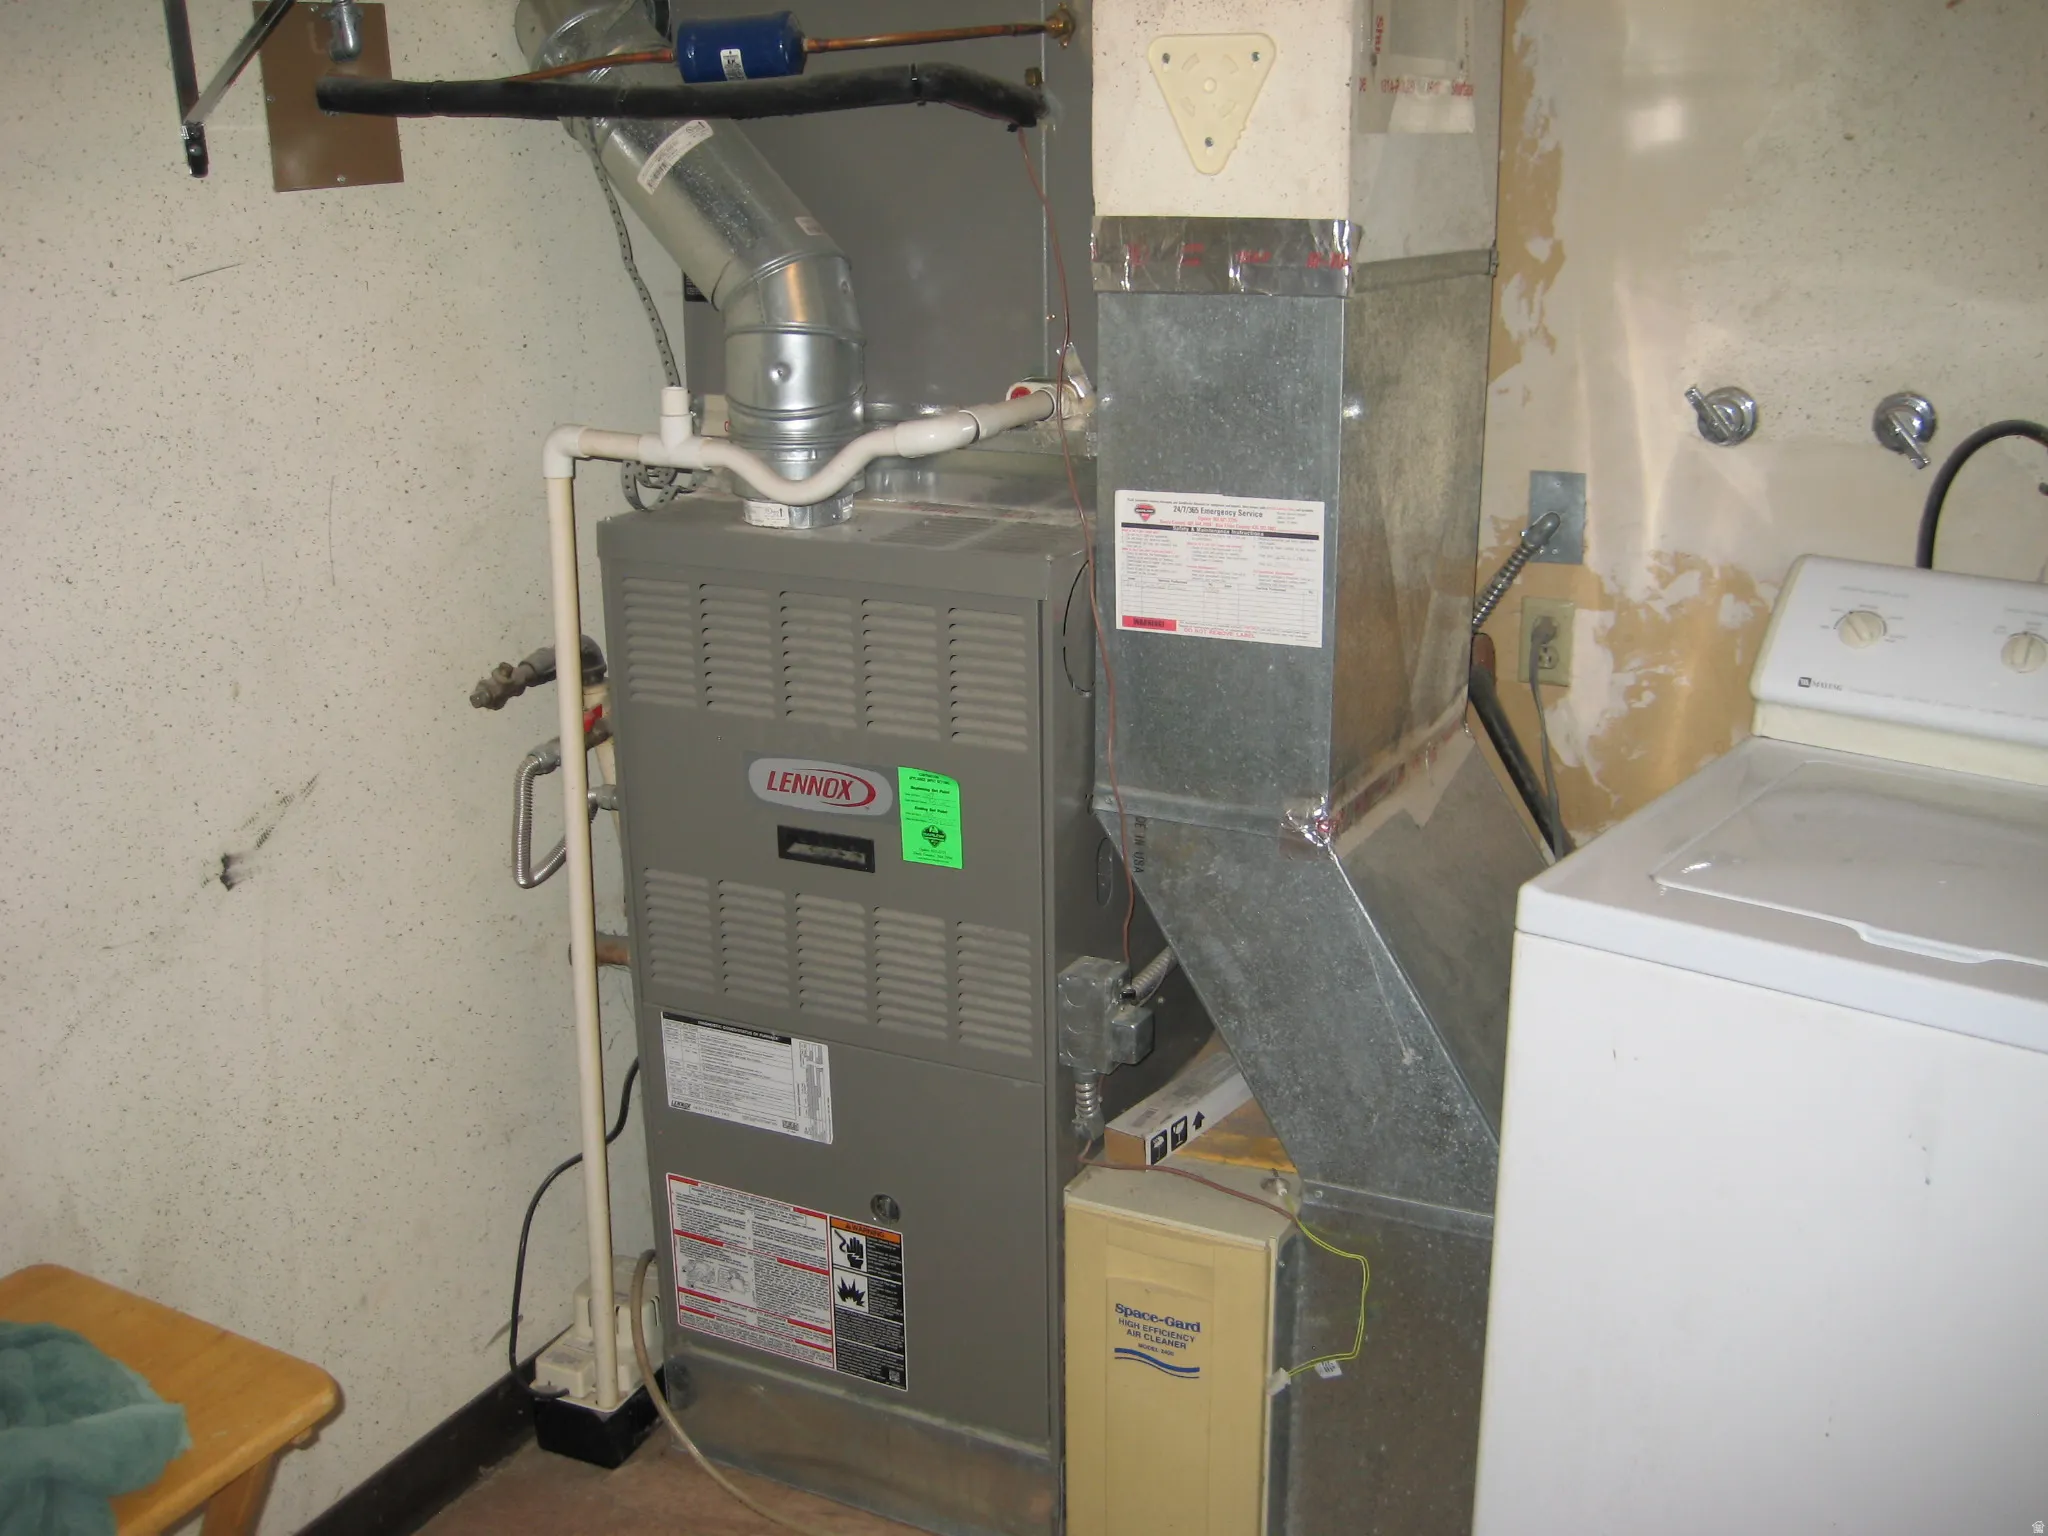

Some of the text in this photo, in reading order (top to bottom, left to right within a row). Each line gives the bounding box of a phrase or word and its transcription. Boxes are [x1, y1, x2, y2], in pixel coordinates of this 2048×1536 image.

[1173, 505, 1199, 515] 24/7/365
[1200, 506, 1236, 518] Emergency
[1237, 508, 1263, 518] Service
[1231, 529, 1264, 537] Instructions
[767, 770, 855, 801] LENNOX
[1133, 834, 1145, 846] IN
[1132, 852, 1145, 874] USA
[852, 1224, 885, 1239] WARNING
[1114, 1302, 1201, 1333] Space-Gard
[1118, 1317, 1196, 1343] HIGH EFFICIENCY
[1126, 1328, 1187, 1350] AIR CLEANER
[1137, 1342, 1159, 1353] MODEL
